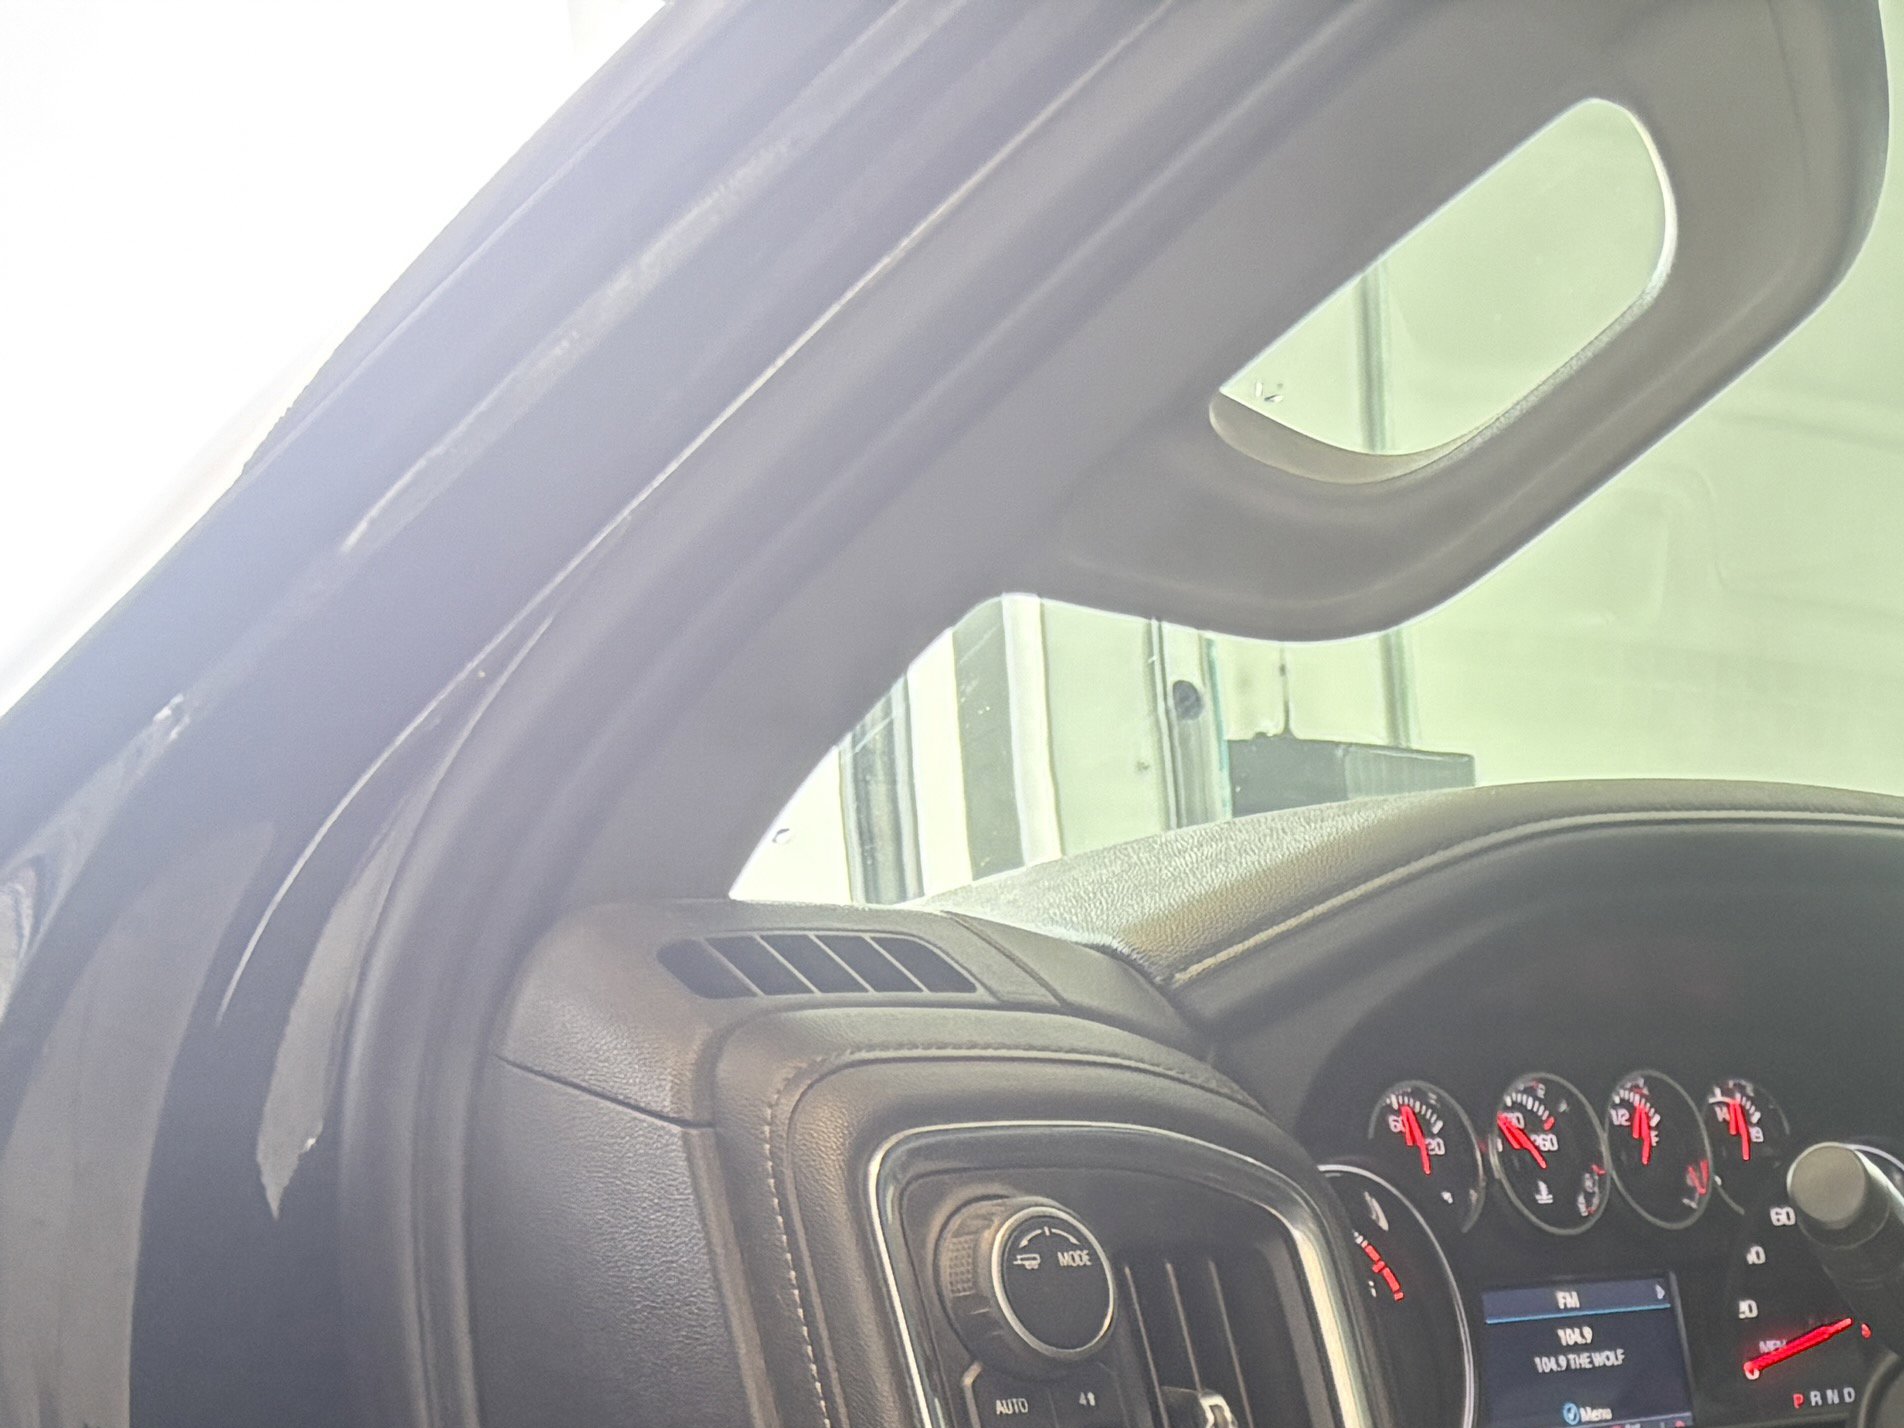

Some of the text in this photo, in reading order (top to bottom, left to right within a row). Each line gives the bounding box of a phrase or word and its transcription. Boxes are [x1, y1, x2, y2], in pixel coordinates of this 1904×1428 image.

[1057, 1250, 1093, 1268] MODE
[1556, 1291, 1581, 1310] FM
[1557, 1326, 1594, 1347] 104.9
[1568, 1352, 1592, 1370] THE
[1591, 1348, 1626, 1367] WOLF
[996, 1398, 1029, 1416] AUTO
[1792, 1387, 1856, 1409] P R N D
